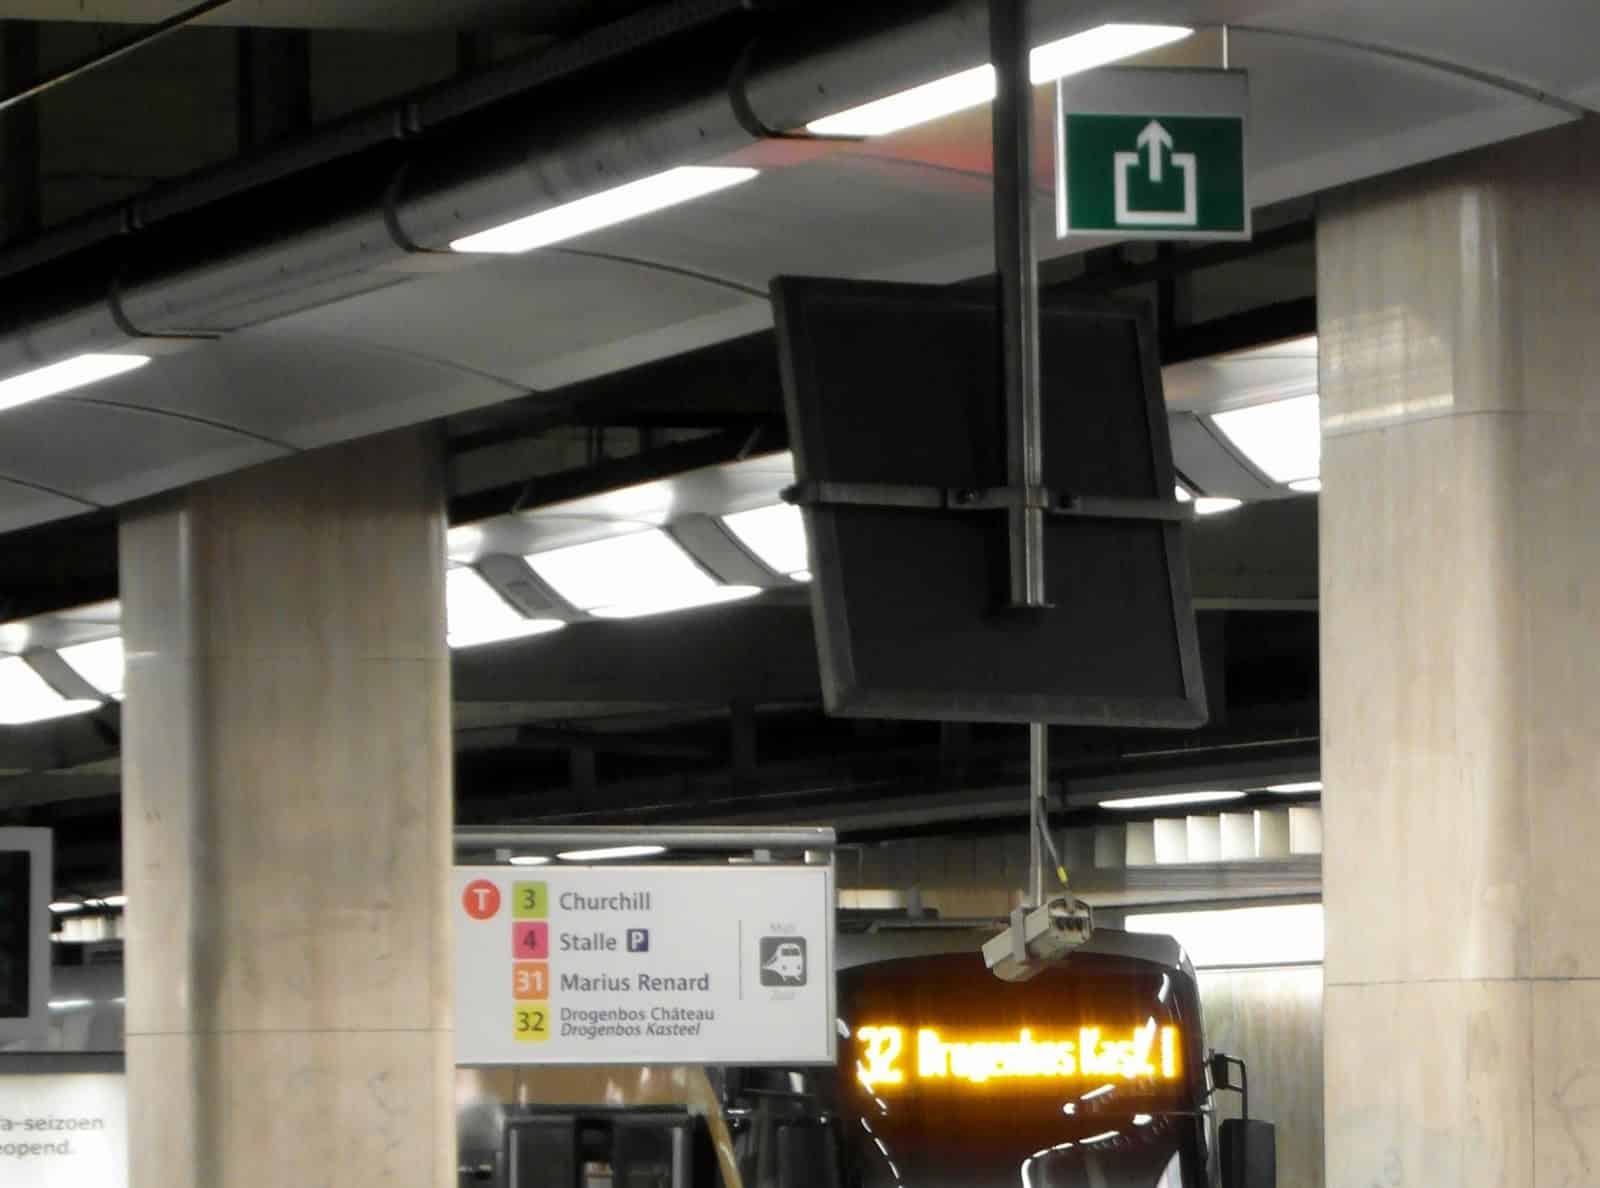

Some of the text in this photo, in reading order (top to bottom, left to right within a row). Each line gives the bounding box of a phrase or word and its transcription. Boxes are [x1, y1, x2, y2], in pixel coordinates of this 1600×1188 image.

[472, 888, 491, 912] T
[522, 889, 652, 911] 3 Churchill
[523, 929, 644, 952] 4 Stalle P
[516, 970, 709, 993] 31 Marius Renard
[516, 1006, 715, 1032] 32 Drogenbos Château
[560, 1022, 701, 1040] Drogenbos Kasteel
[856, 1026, 903, 1083] 32
